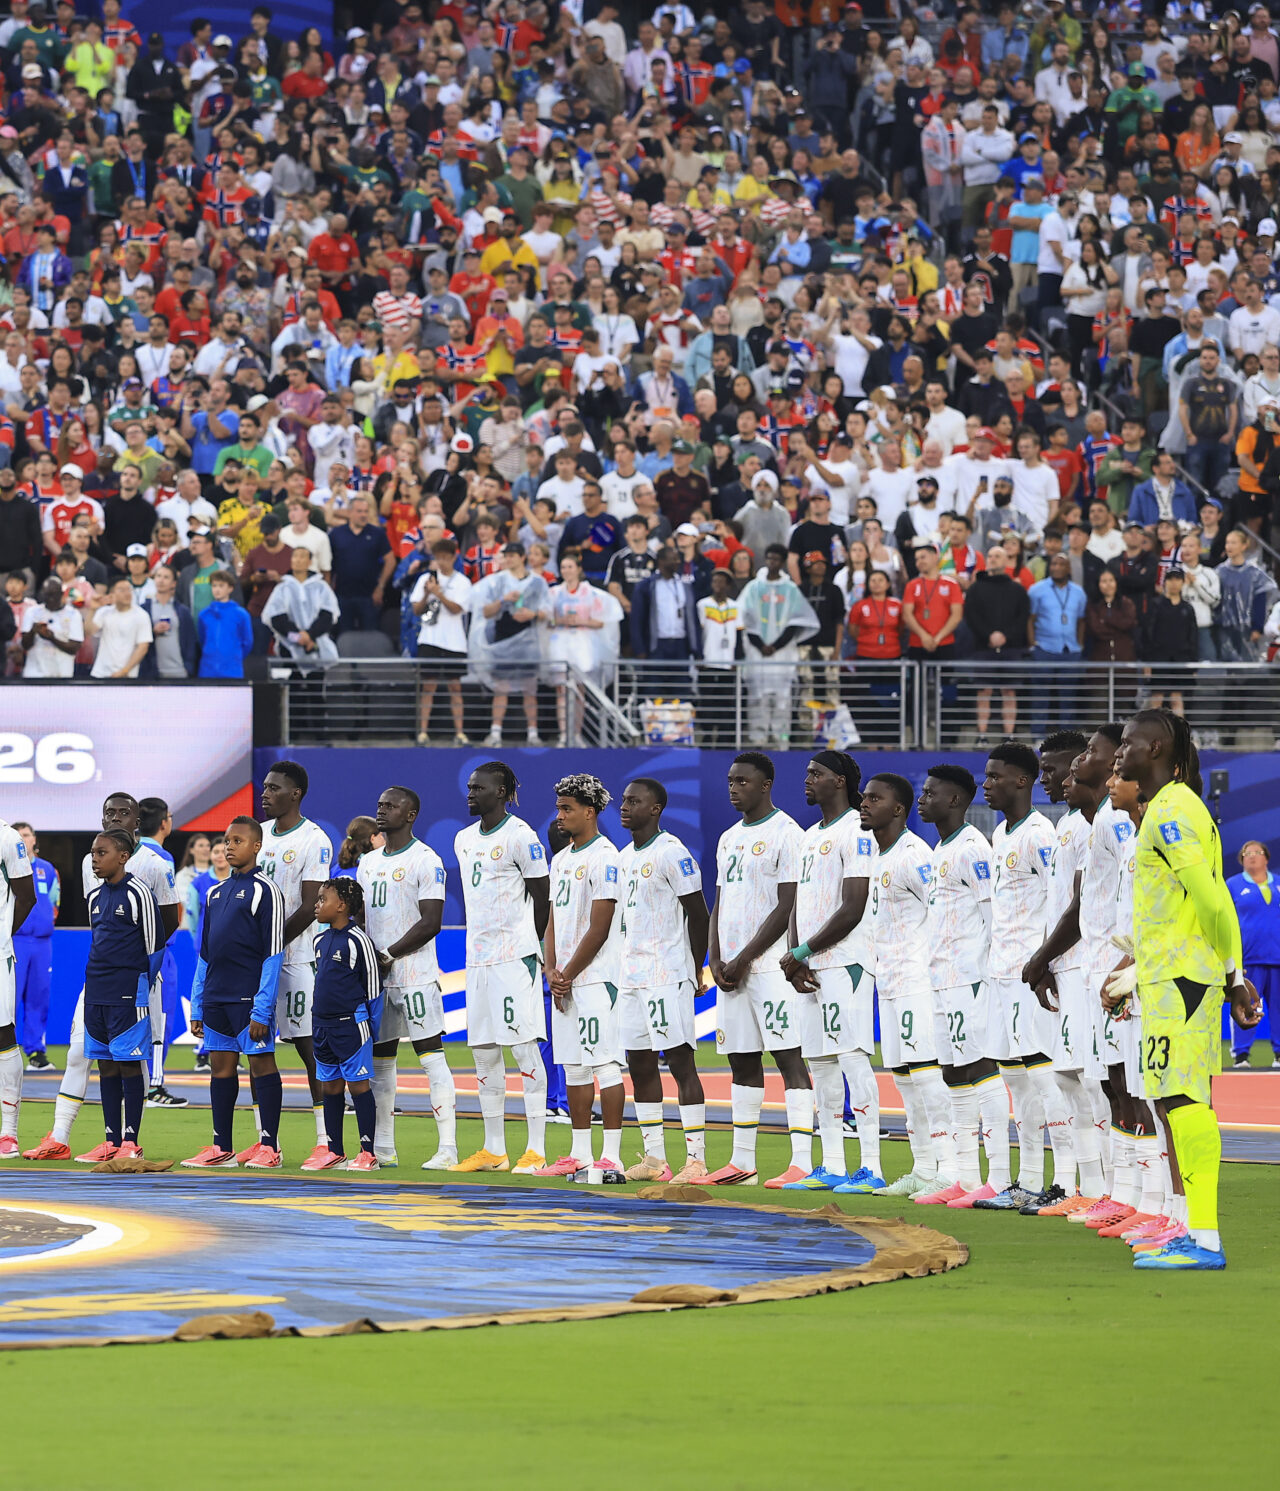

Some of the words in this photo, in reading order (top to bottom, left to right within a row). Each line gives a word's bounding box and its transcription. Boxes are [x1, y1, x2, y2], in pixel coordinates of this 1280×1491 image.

[471, 861, 482, 888] 6
[726, 853, 744, 883] 24
[800, 854, 815, 884] 12
[371, 880, 388, 908] 10
[872, 886, 879, 915] 9
[285, 990, 306, 1018] 18
[403, 991, 426, 1021] 10
[503, 996, 515, 1024] 6
[648, 998, 669, 1028] 21
[763, 1000, 789, 1030] 24
[822, 1002, 841, 1032] 12
[1013, 1001, 1020, 1033] 7
[578, 1016, 600, 1045] 20
[900, 1010, 913, 1040] 9
[1147, 1035, 1171, 1070] 23
